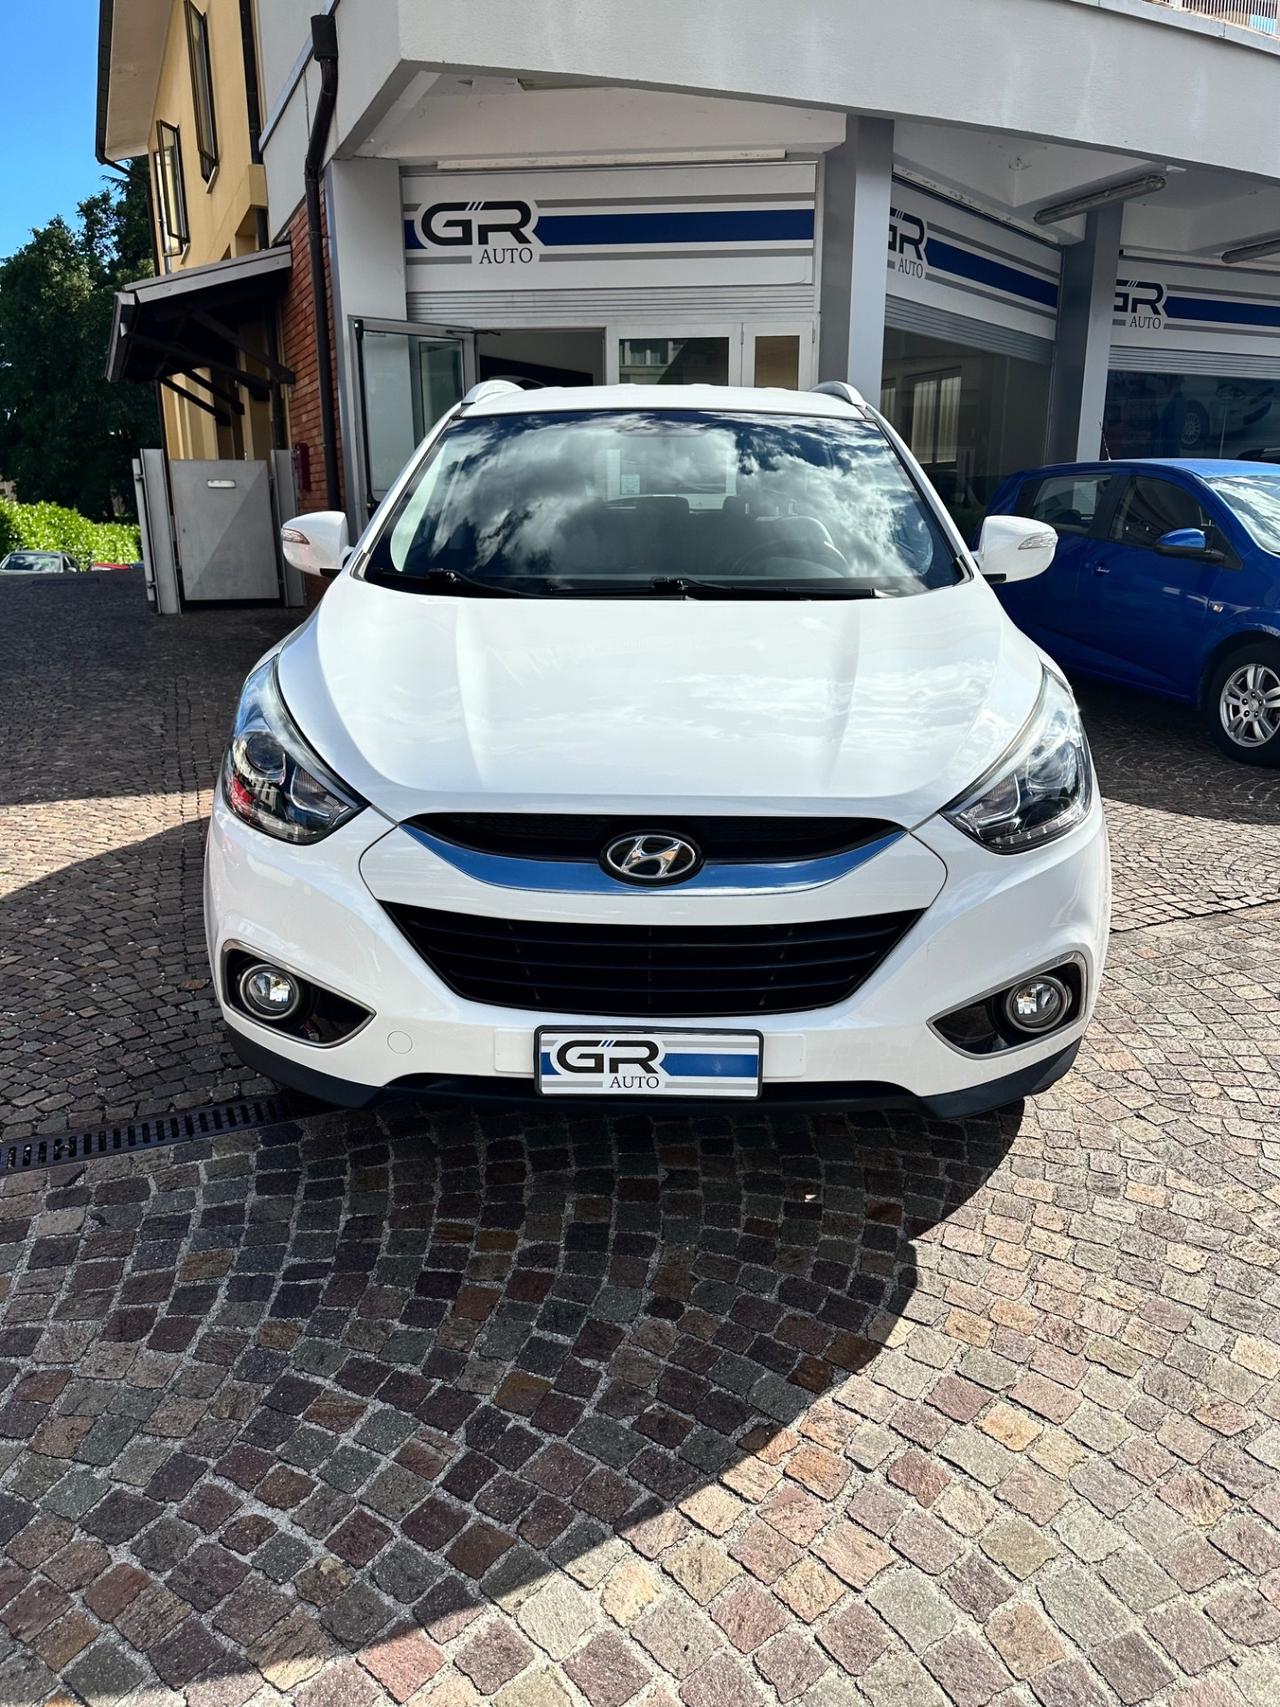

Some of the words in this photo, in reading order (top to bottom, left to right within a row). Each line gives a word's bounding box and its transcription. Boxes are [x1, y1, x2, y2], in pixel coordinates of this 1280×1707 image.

[421, 201, 532, 245] GR
[480, 248, 533, 264] AUTO
[898, 258, 924, 279] AUTO
[1129, 316, 1162, 329] AUTO
[556, 1039, 659, 1074] GR
[609, 1075, 660, 1089] AUTO
